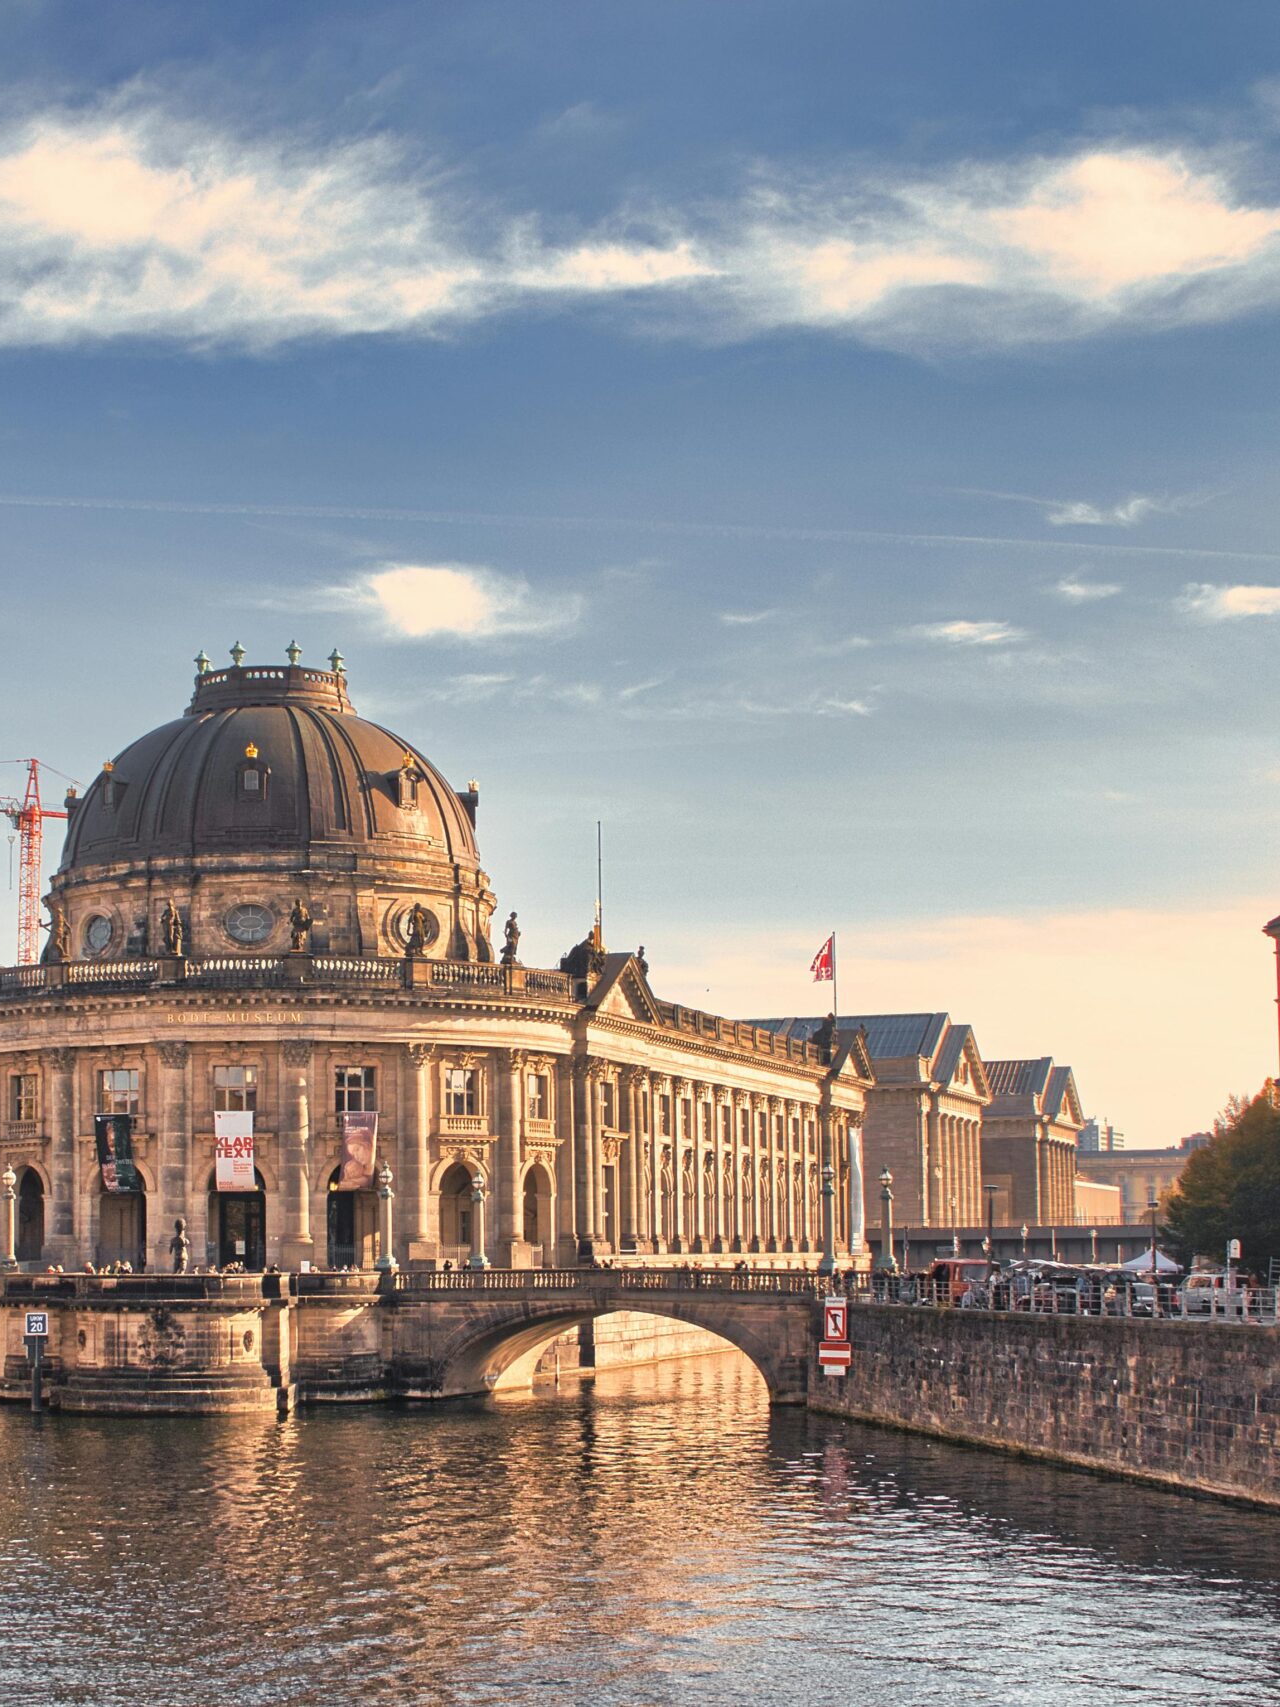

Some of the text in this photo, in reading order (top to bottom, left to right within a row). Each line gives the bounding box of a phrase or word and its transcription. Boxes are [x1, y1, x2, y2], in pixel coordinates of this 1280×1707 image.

[214, 1136, 254, 1148] KLAR
[215, 1147, 254, 1158] TEXT
[30, 1322, 43, 1332] 20
